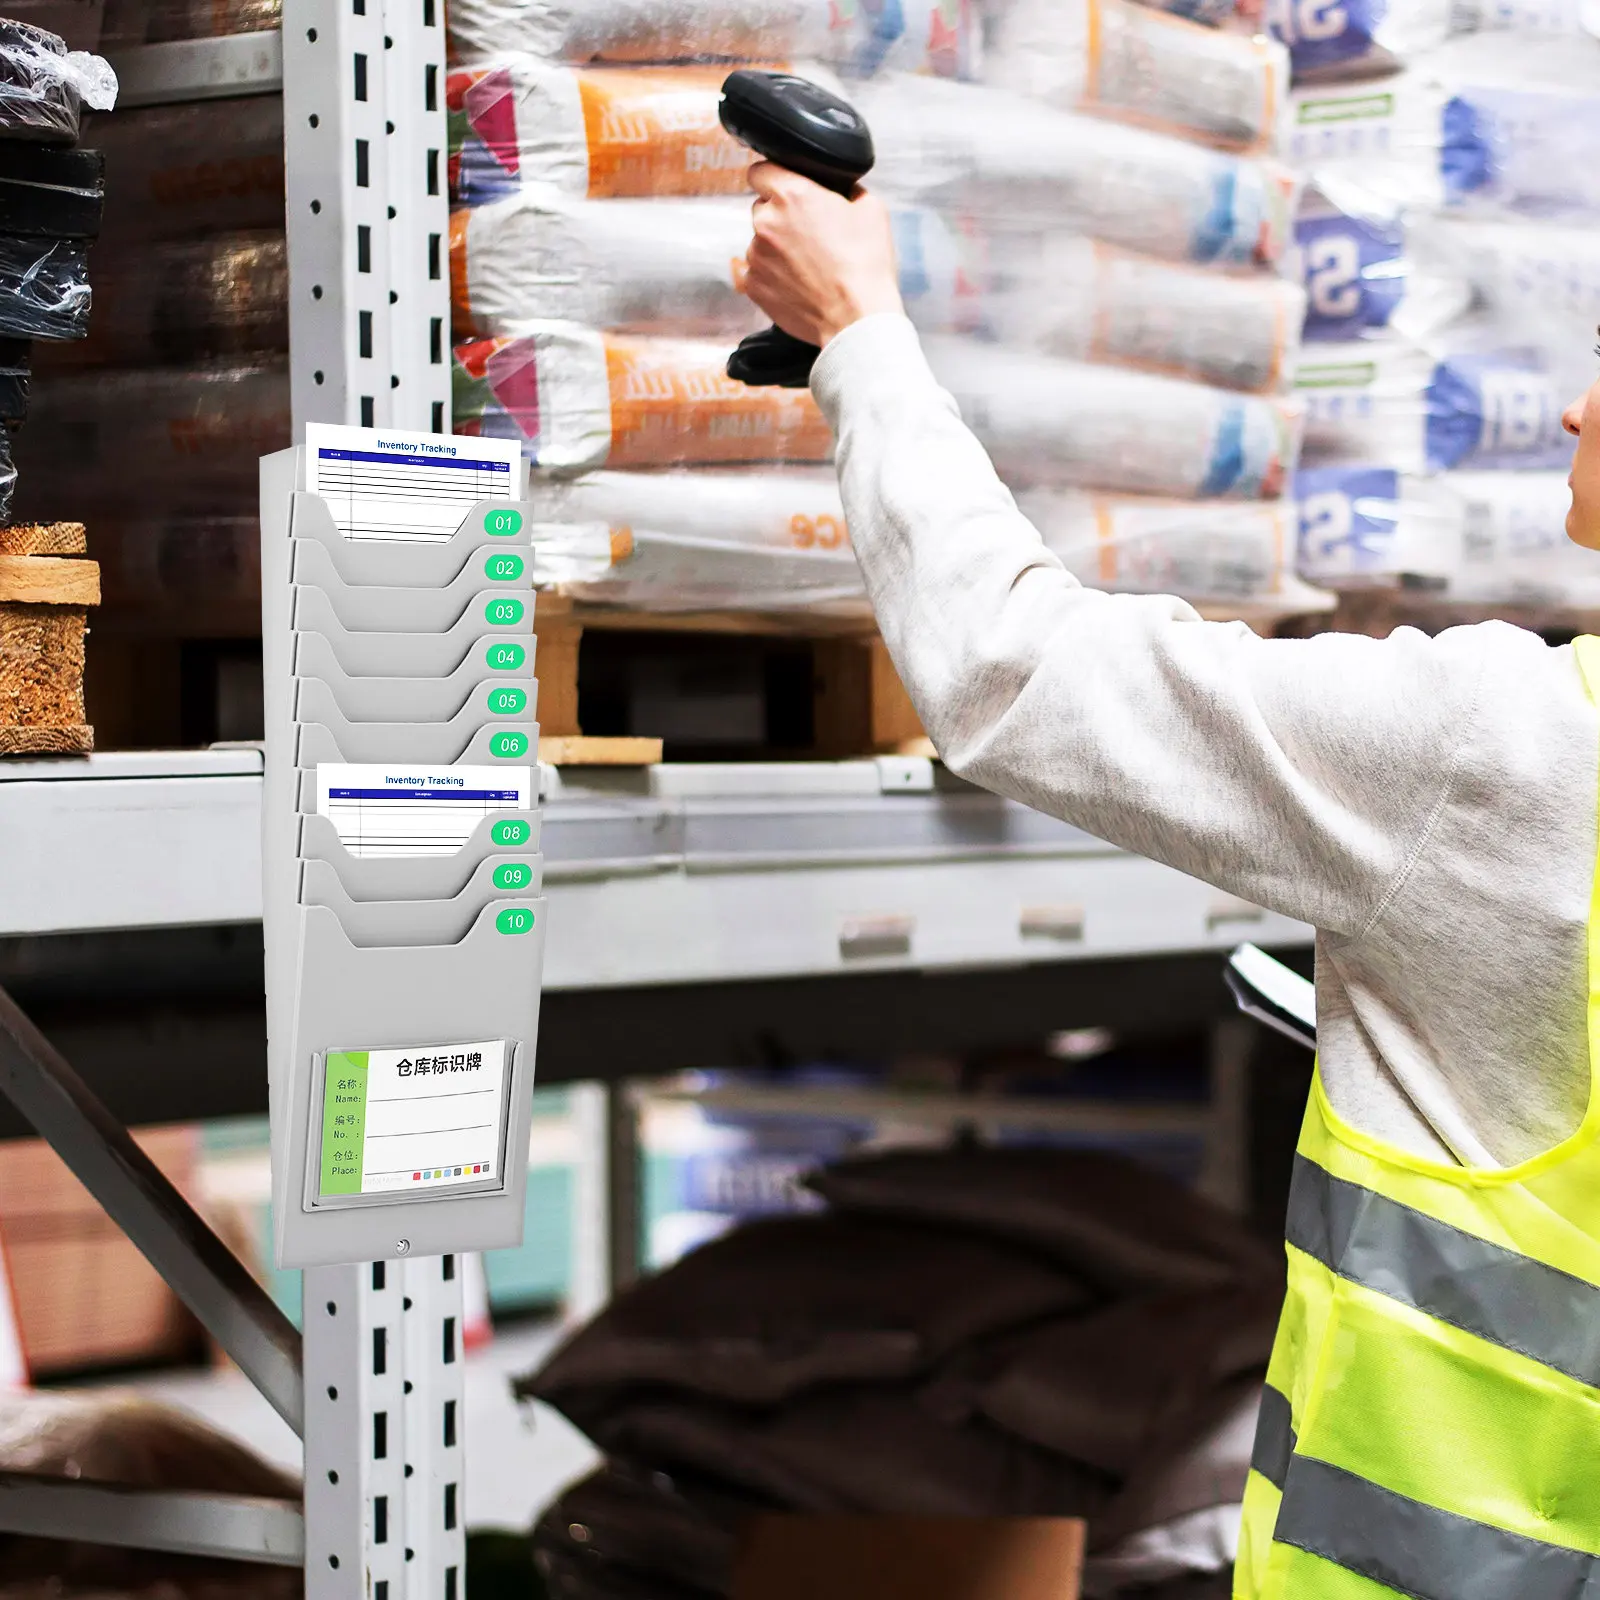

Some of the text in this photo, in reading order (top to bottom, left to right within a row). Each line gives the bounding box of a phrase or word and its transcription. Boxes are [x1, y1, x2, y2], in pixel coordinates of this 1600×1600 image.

[377, 439, 457, 457] Inventory Tracking
[495, 515, 512, 530] 01
[496, 560, 514, 575] 02
[495, 605, 514, 619] 03
[497, 649, 515, 664] 04
[498, 693, 517, 708] 05
[501, 738, 519, 752] 06
[385, 775, 464, 788] Inventory Tracking
[502, 826, 521, 840] 08
[503, 869, 522, 884] 09
[507, 914, 524, 928] 10
[396, 1052, 483, 1078] 仓库标识牌
[335, 1095, 361, 1103] Name:
[331, 1166, 358, 1175] Place:
